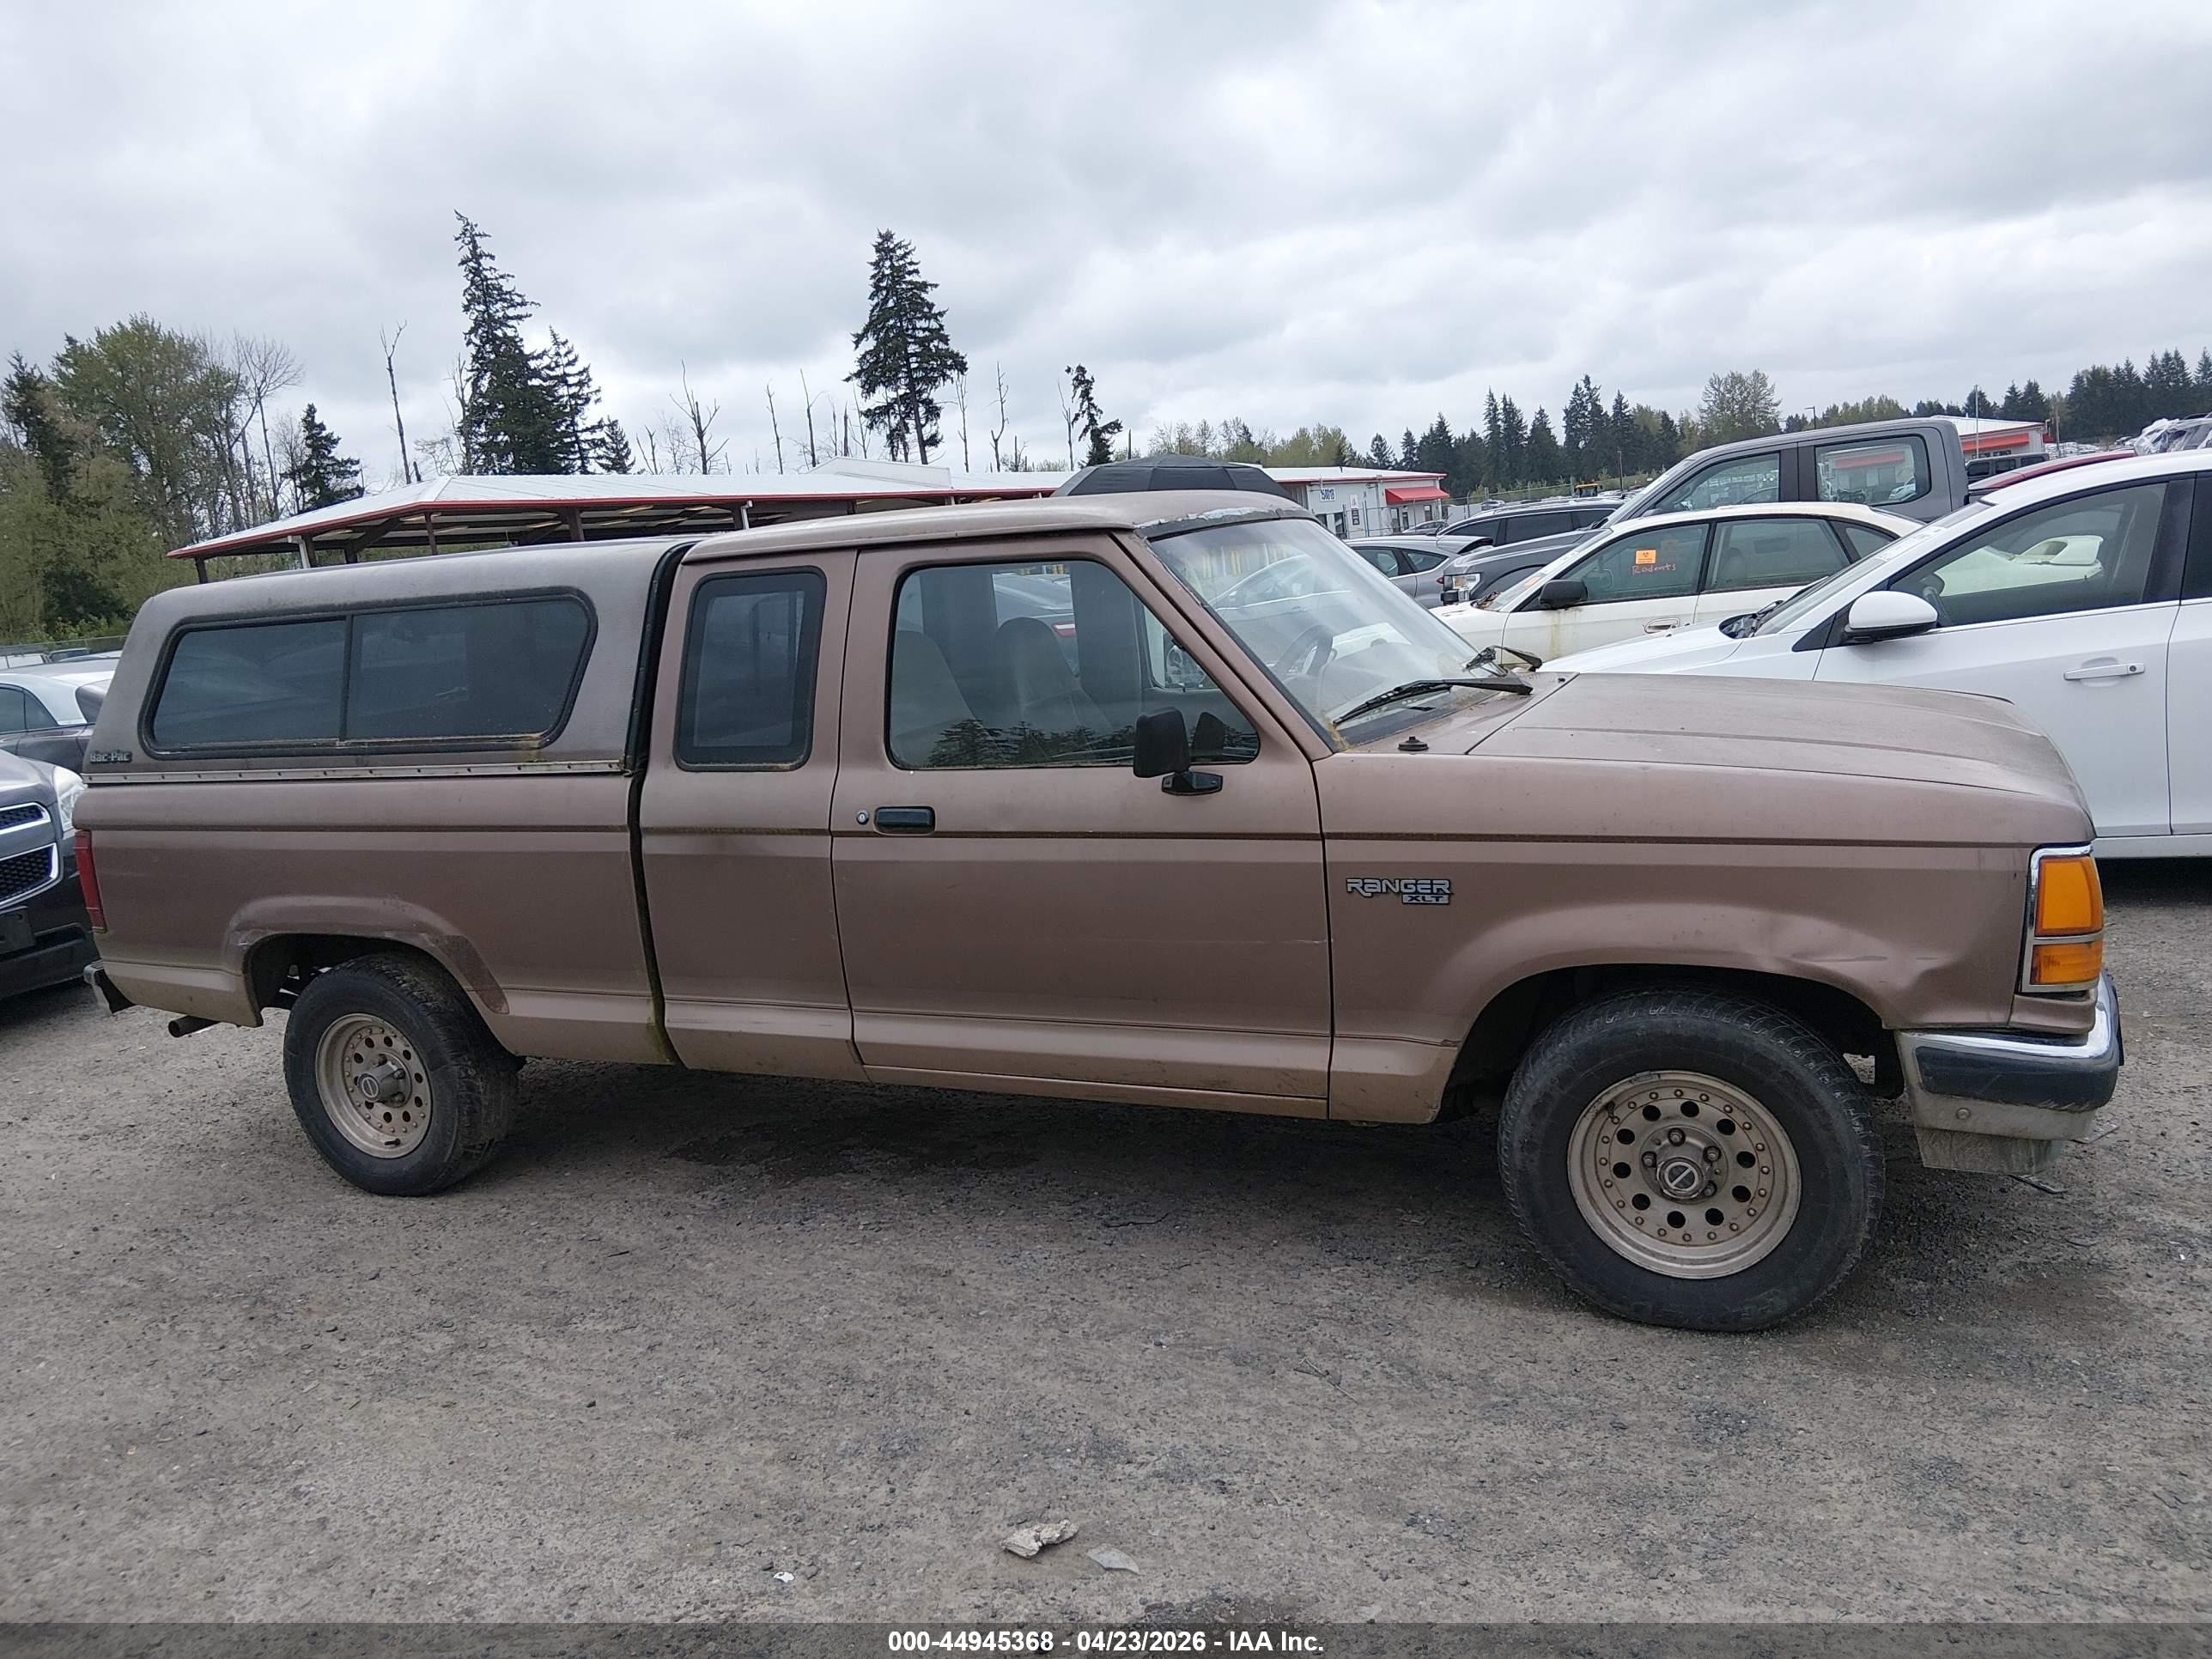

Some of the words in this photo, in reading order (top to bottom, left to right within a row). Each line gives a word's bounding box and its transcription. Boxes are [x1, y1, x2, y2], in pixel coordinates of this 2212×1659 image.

[1632, 563, 1676, 576] Rodents
[1346, 878, 1451, 897] RANGER
[1406, 895, 1446, 903] XLT
